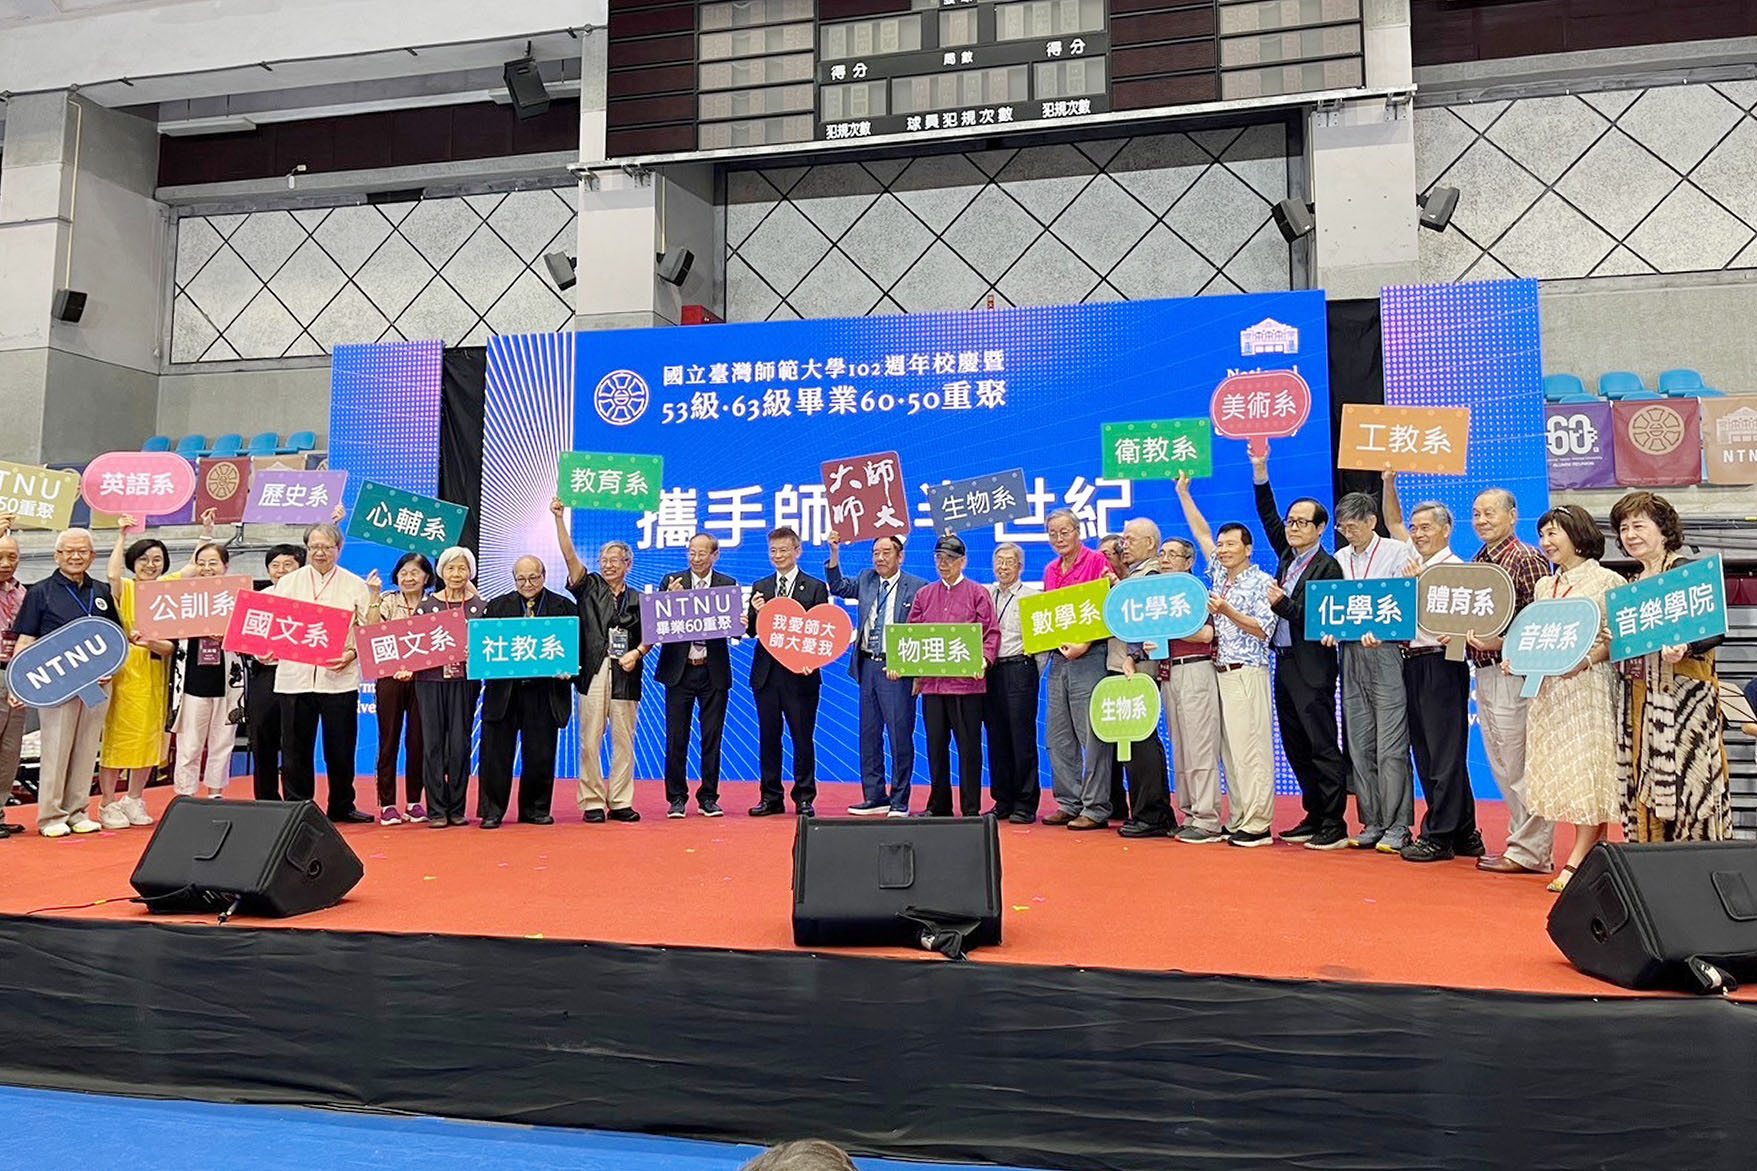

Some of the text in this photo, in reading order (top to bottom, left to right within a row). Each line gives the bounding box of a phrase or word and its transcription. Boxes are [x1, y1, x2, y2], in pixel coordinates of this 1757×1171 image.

[943, 51, 973, 66] 局數
[1046, 38, 1086, 57] 得分
[830, 62, 868, 81] 得分
[905, 106, 1014, 132] 球員犯規次數
[1041, 98, 1092, 119] 犯規次數
[825, 121, 872, 140] 犯規次數
[663, 349, 1006, 387] 國立臺灣師範大學102週年校慶暨
[1221, 388, 1297, 420] 美術系
[1115, 435, 1198, 465] 衛教系
[1356, 424, 1452, 455] 工教系
[100, 471, 175, 497] 英語系
[258, 483, 329, 508] 歷史系
[570, 467, 649, 496] 教育系
[941, 484, 1016, 521] 生物系
[366, 501, 447, 542] 心輔系
[149, 591, 236, 621] 公訓系
[655, 593, 731, 619] NTNU
[1121, 592, 1192, 624] 化學系
[1318, 593, 1402, 625] 化學系
[1426, 585, 1495, 616] 體育系
[1615, 582, 1716, 638] 音樂學院
[241, 607, 329, 649] 國文系
[655, 614, 732, 636] 畢業60重聚
[772, 614, 837, 638] 我愛師大
[1031, 598, 1102, 636] 數學系
[370, 624, 456, 664] 國文系
[482, 634, 565, 662] 社教系
[769, 632, 834, 657] 師大愛我
[897, 636, 971, 663] 物理系
[1518, 621, 1581, 651] 音樂系
[26, 634, 107, 690] NTNU
[1101, 693, 1148, 722] 生物系
